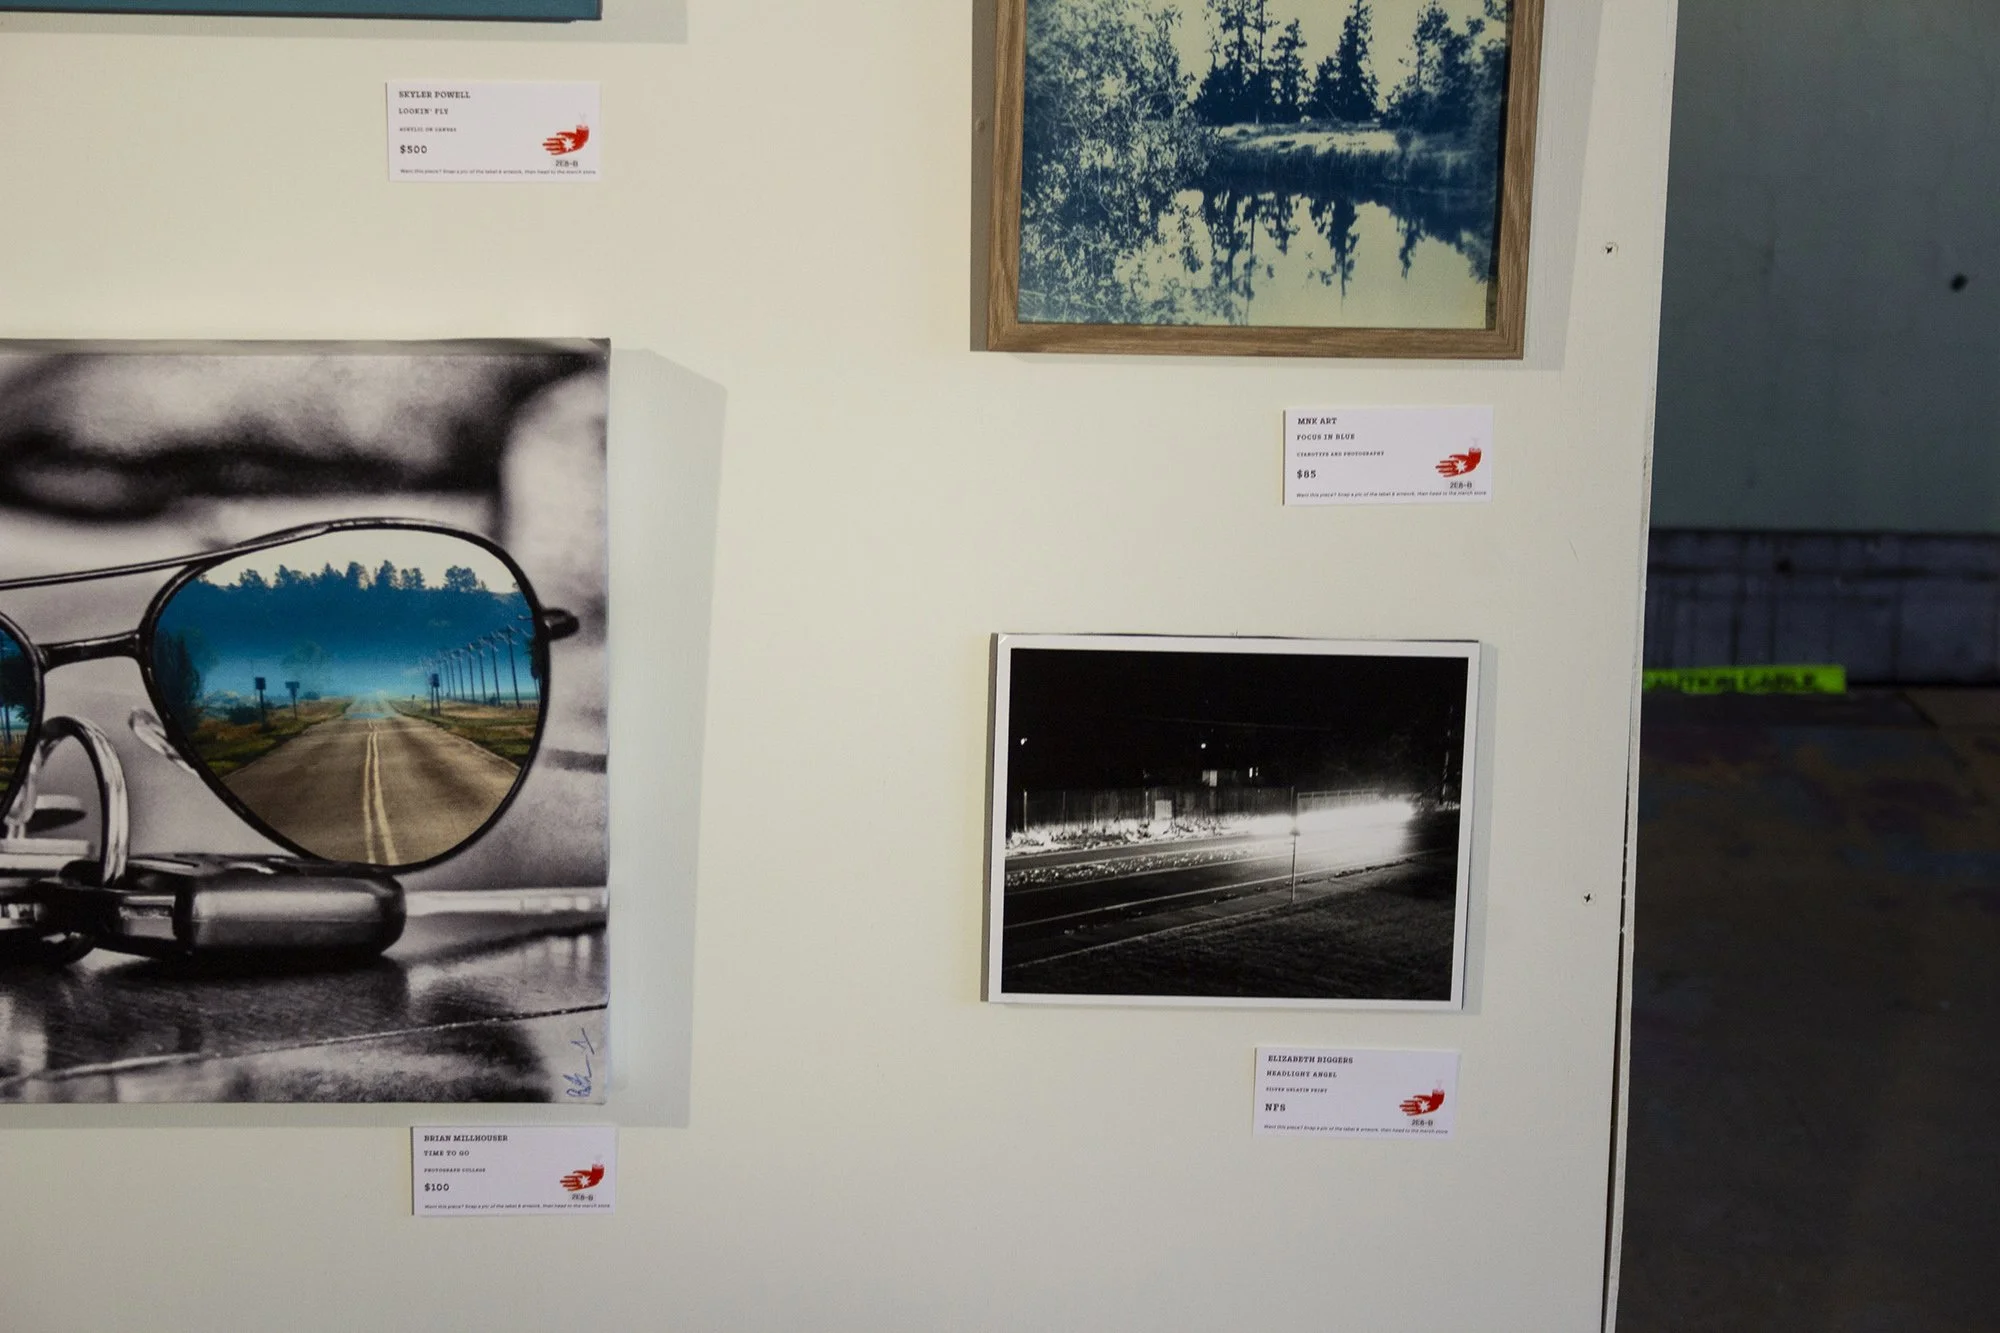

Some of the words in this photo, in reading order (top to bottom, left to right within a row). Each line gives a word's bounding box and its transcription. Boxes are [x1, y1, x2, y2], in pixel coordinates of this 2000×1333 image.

[434, 91, 471, 99] POWELL
[400, 144, 427, 154] $500
[1297, 469, 1316, 479] $85
[1268, 1055, 1315, 1063] ELIZABETH
[1317, 1056, 1353, 1064] BIGGERS
[1265, 1103, 1286, 1112] NFS
[425, 1183, 449, 1192] $100
